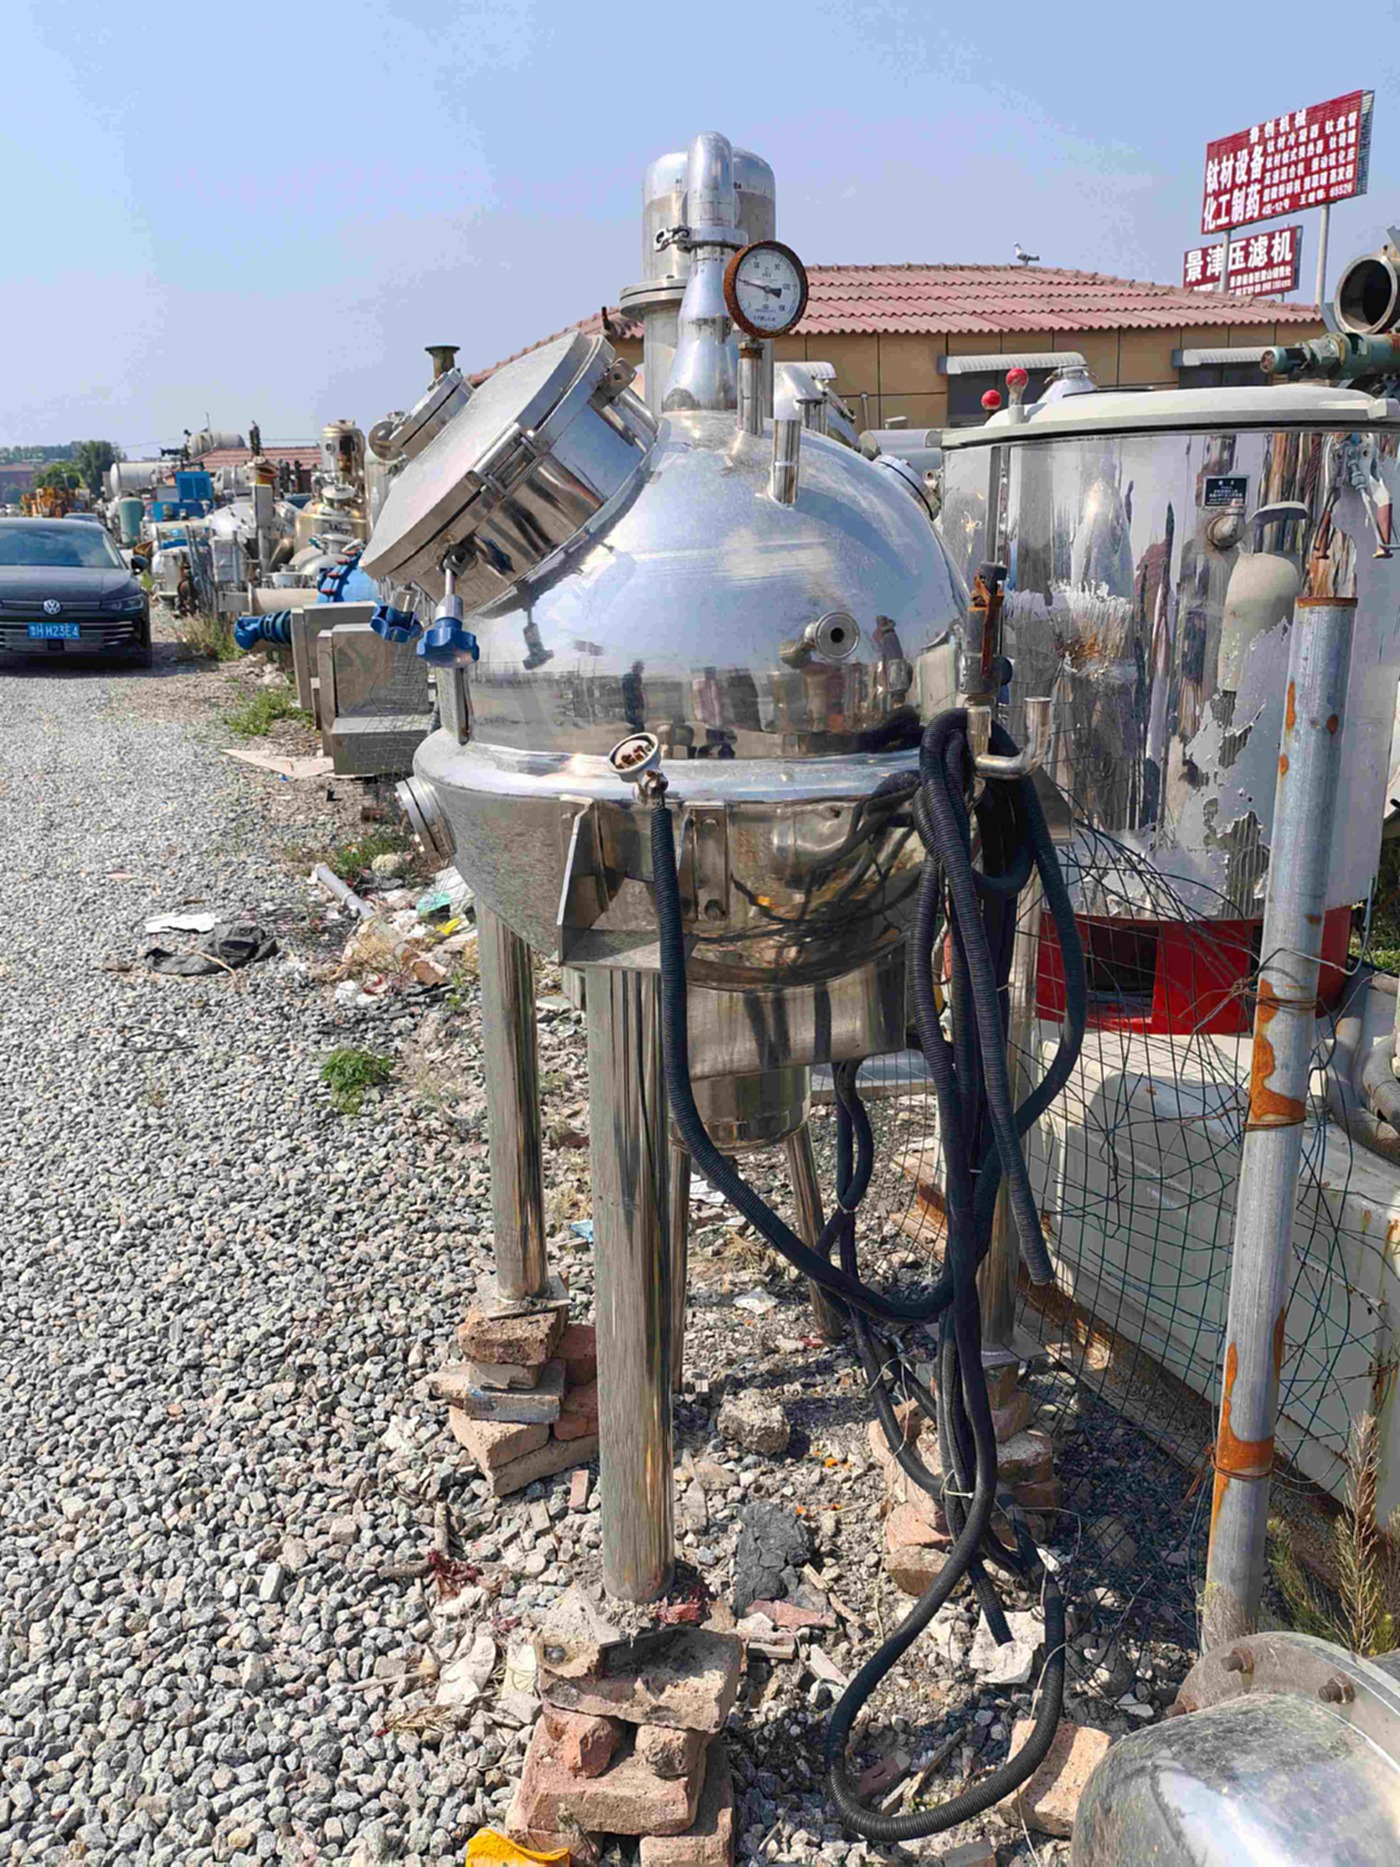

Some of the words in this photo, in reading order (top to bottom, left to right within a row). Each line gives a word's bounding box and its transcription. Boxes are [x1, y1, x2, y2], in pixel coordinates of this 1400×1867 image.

[1206, 145, 1264, 195] 钛材设备
[1203, 183, 1260, 232] 化工制药
[1185, 230, 1293, 282] 景津压滤机
